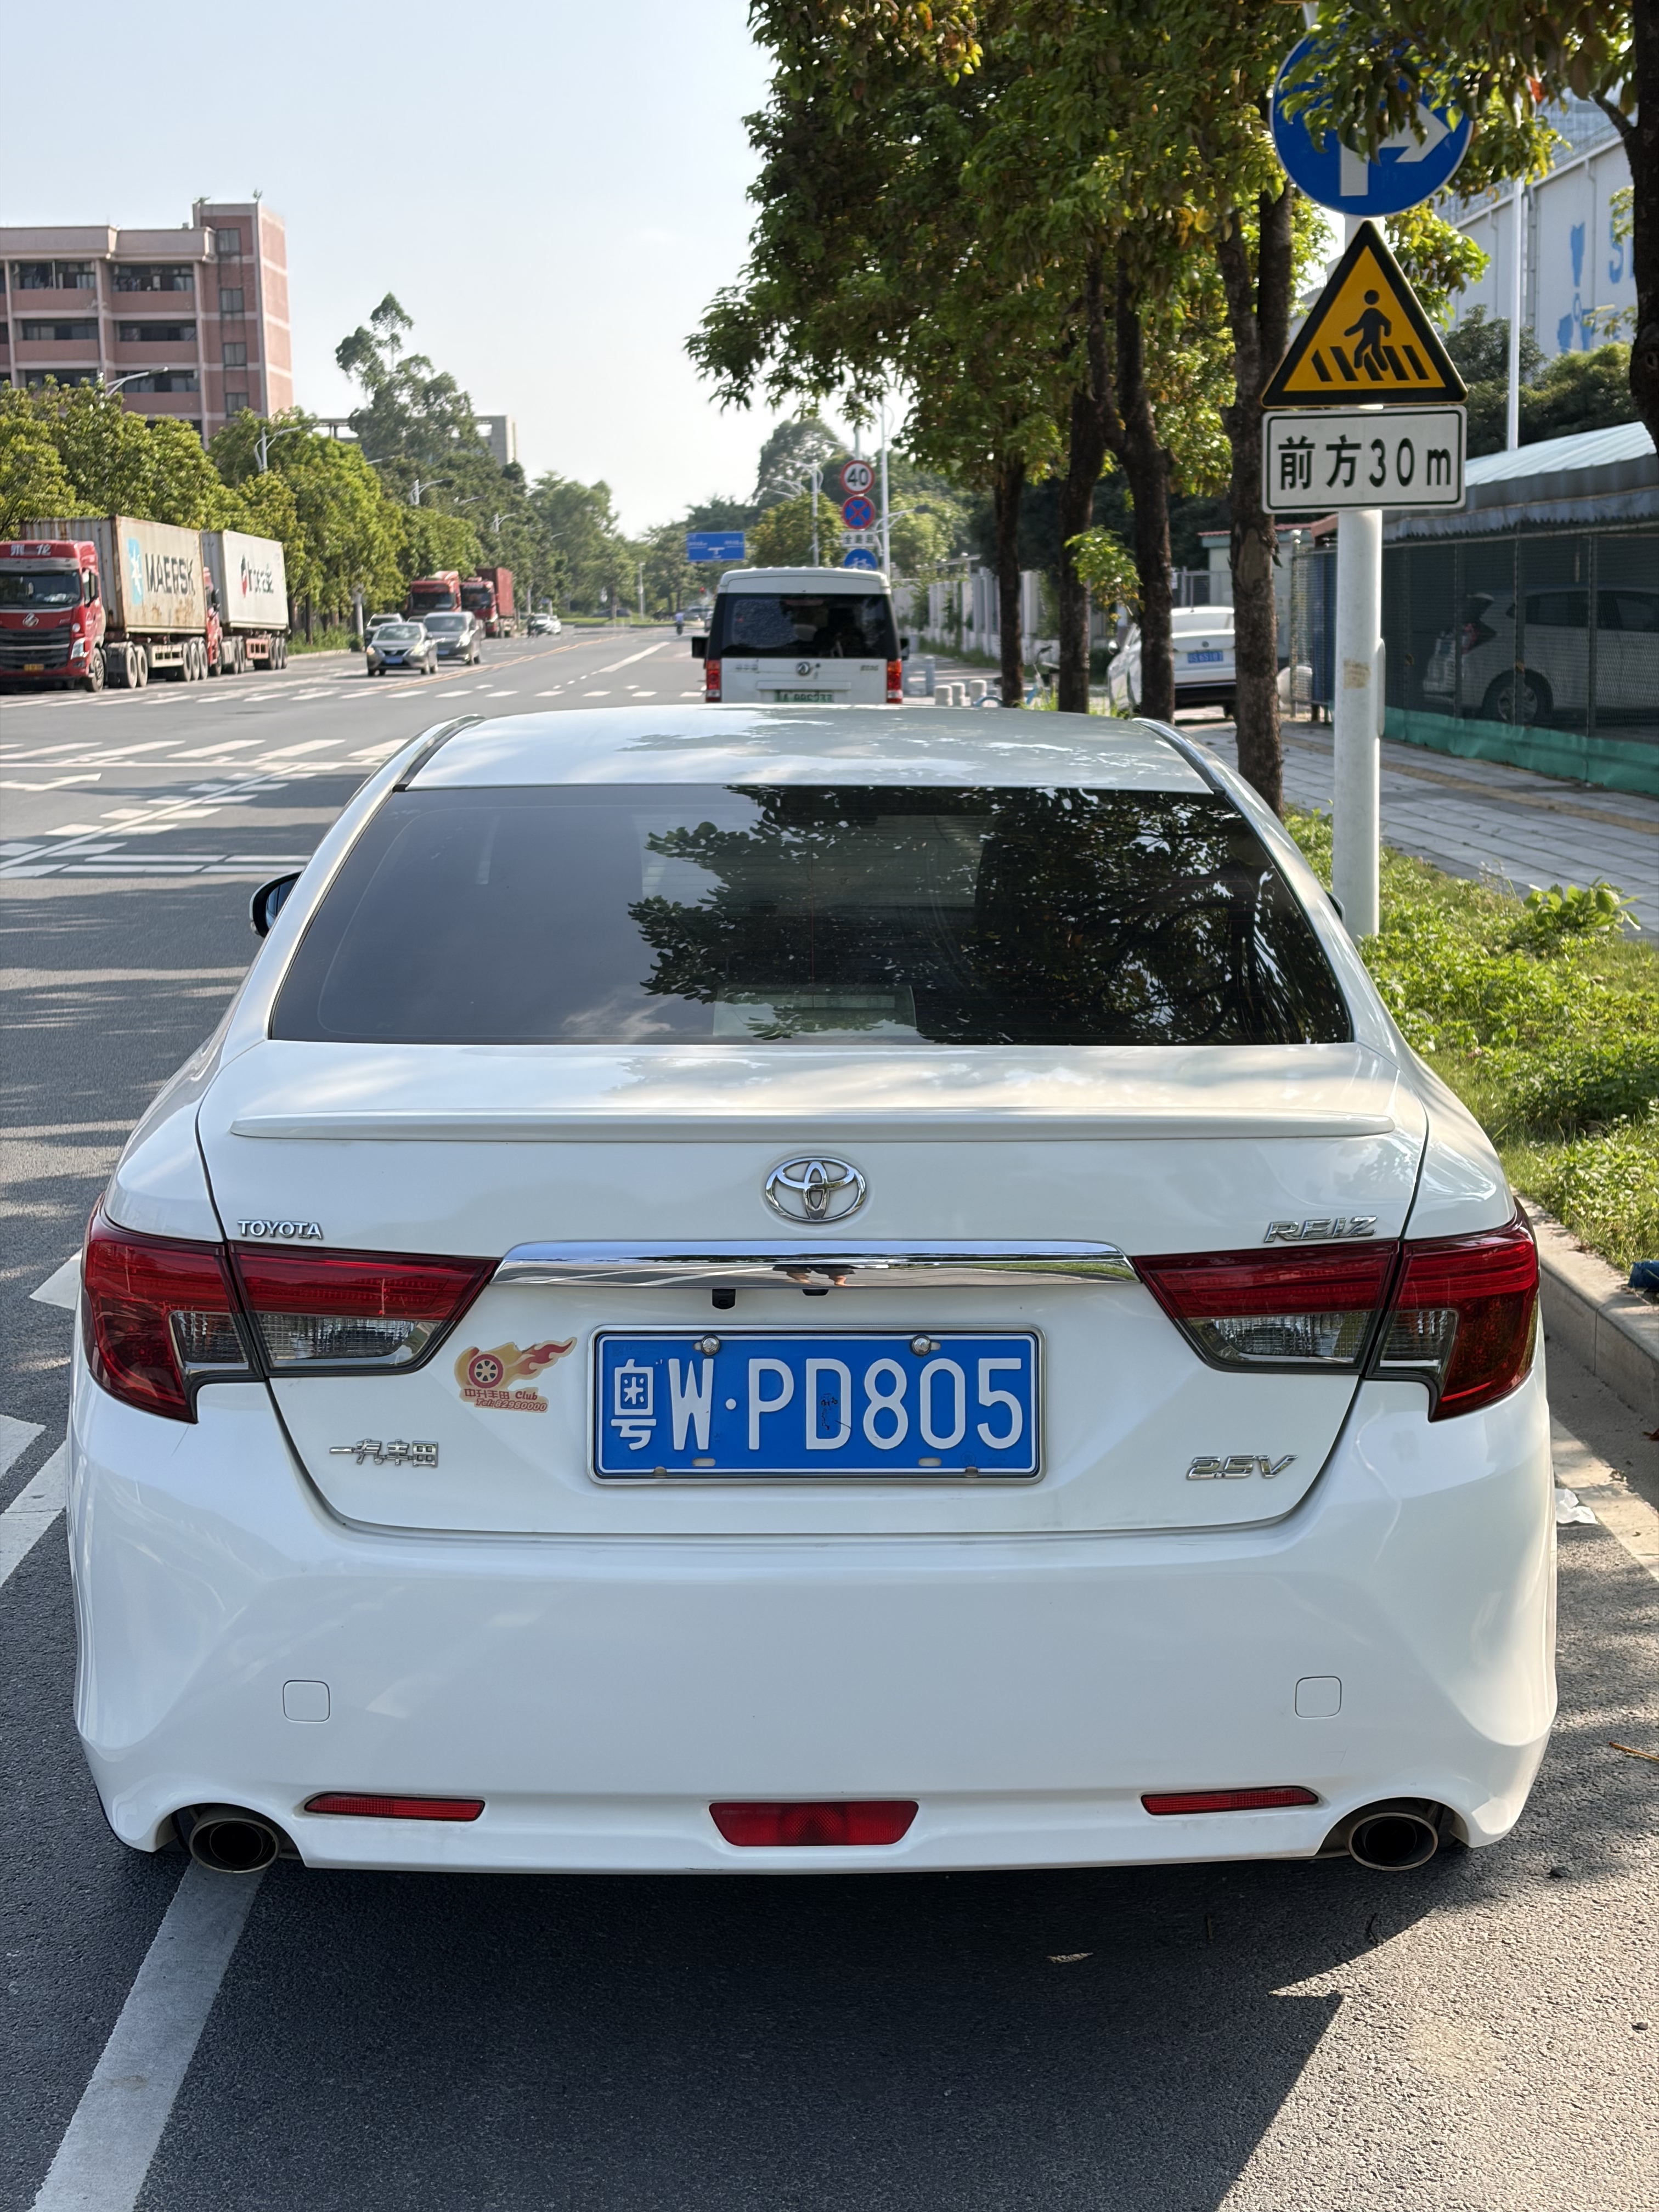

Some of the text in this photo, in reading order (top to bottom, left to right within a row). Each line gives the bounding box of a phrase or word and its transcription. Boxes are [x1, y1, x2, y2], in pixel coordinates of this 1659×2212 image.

[1278, 434, 1452, 490] 前方30m
[847, 468, 868, 487] 40
[145, 552, 195, 596] MAERSK
[237, 1219, 324, 1239] TOYOTA
[1263, 1215, 1378, 1243] REIZ
[464, 1388, 538, 1401] 中升丰田 Club
[329, 1438, 438, 1468] 一汽丰田
[1186, 1454, 1299, 1481] 2.5V
